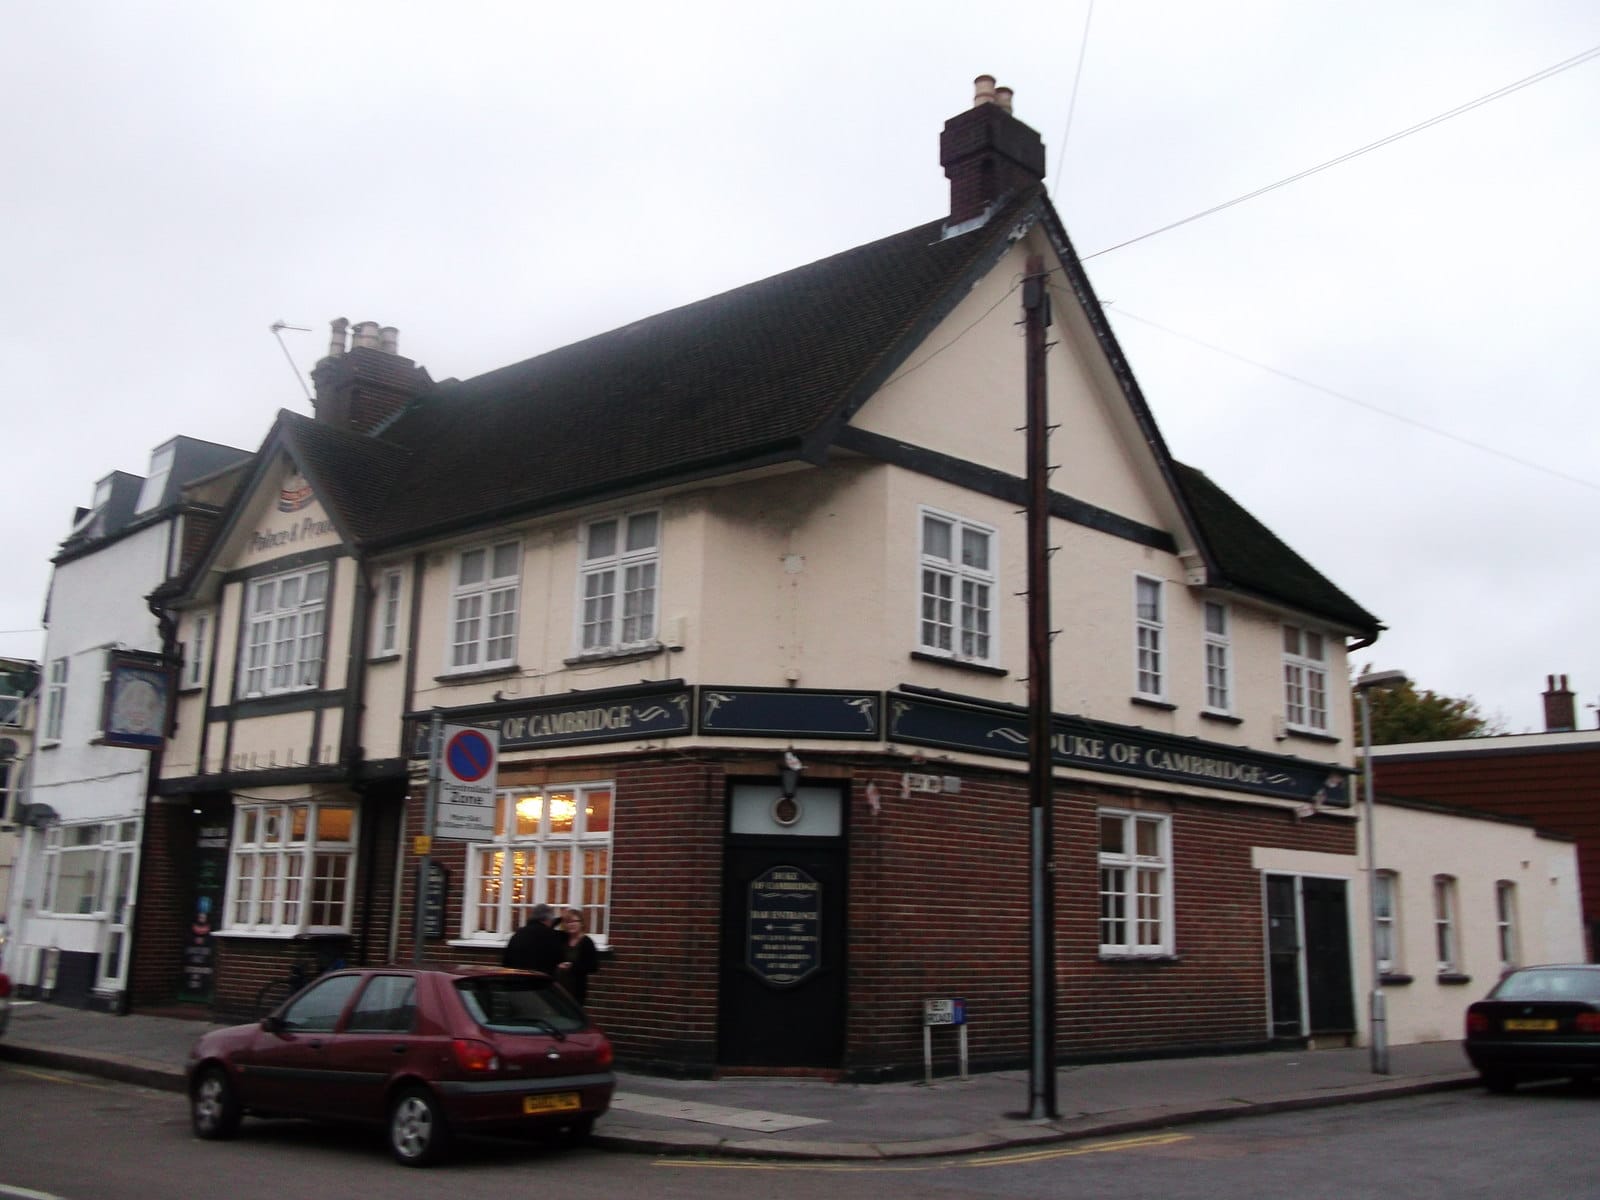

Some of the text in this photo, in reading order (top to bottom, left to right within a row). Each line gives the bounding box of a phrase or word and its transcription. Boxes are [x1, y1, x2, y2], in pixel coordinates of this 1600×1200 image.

[502, 705, 632, 739] OF CAMBRIDGE
[1109, 742, 1142, 765] OF
[1145, 748, 1264, 784] CAMBRIDGE
[451, 791, 483, 805] Zone
